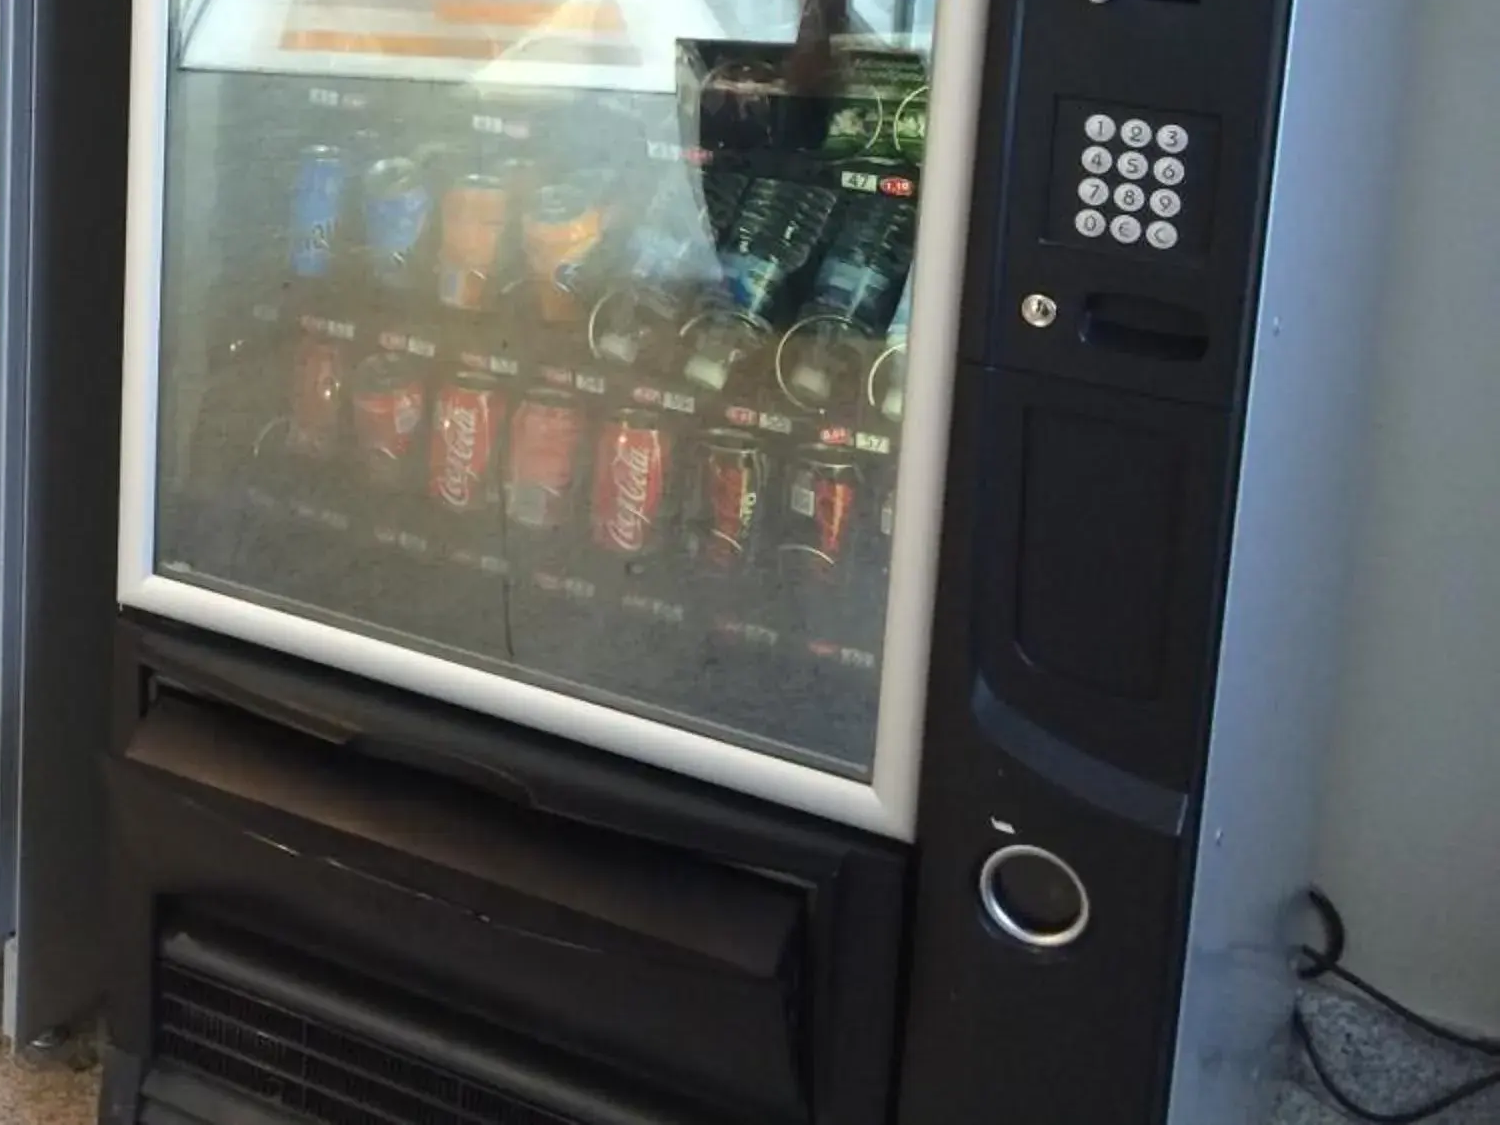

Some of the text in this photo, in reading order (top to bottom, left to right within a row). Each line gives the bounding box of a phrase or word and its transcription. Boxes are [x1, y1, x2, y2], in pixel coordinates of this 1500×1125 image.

[1130, 125, 1144, 143] 2
[1166, 130, 1179, 148] 3
[1090, 152, 1176, 181] 4 5 6
[1088, 183, 1173, 213] 7 8 9
[1084, 215, 1097, 232] 0
